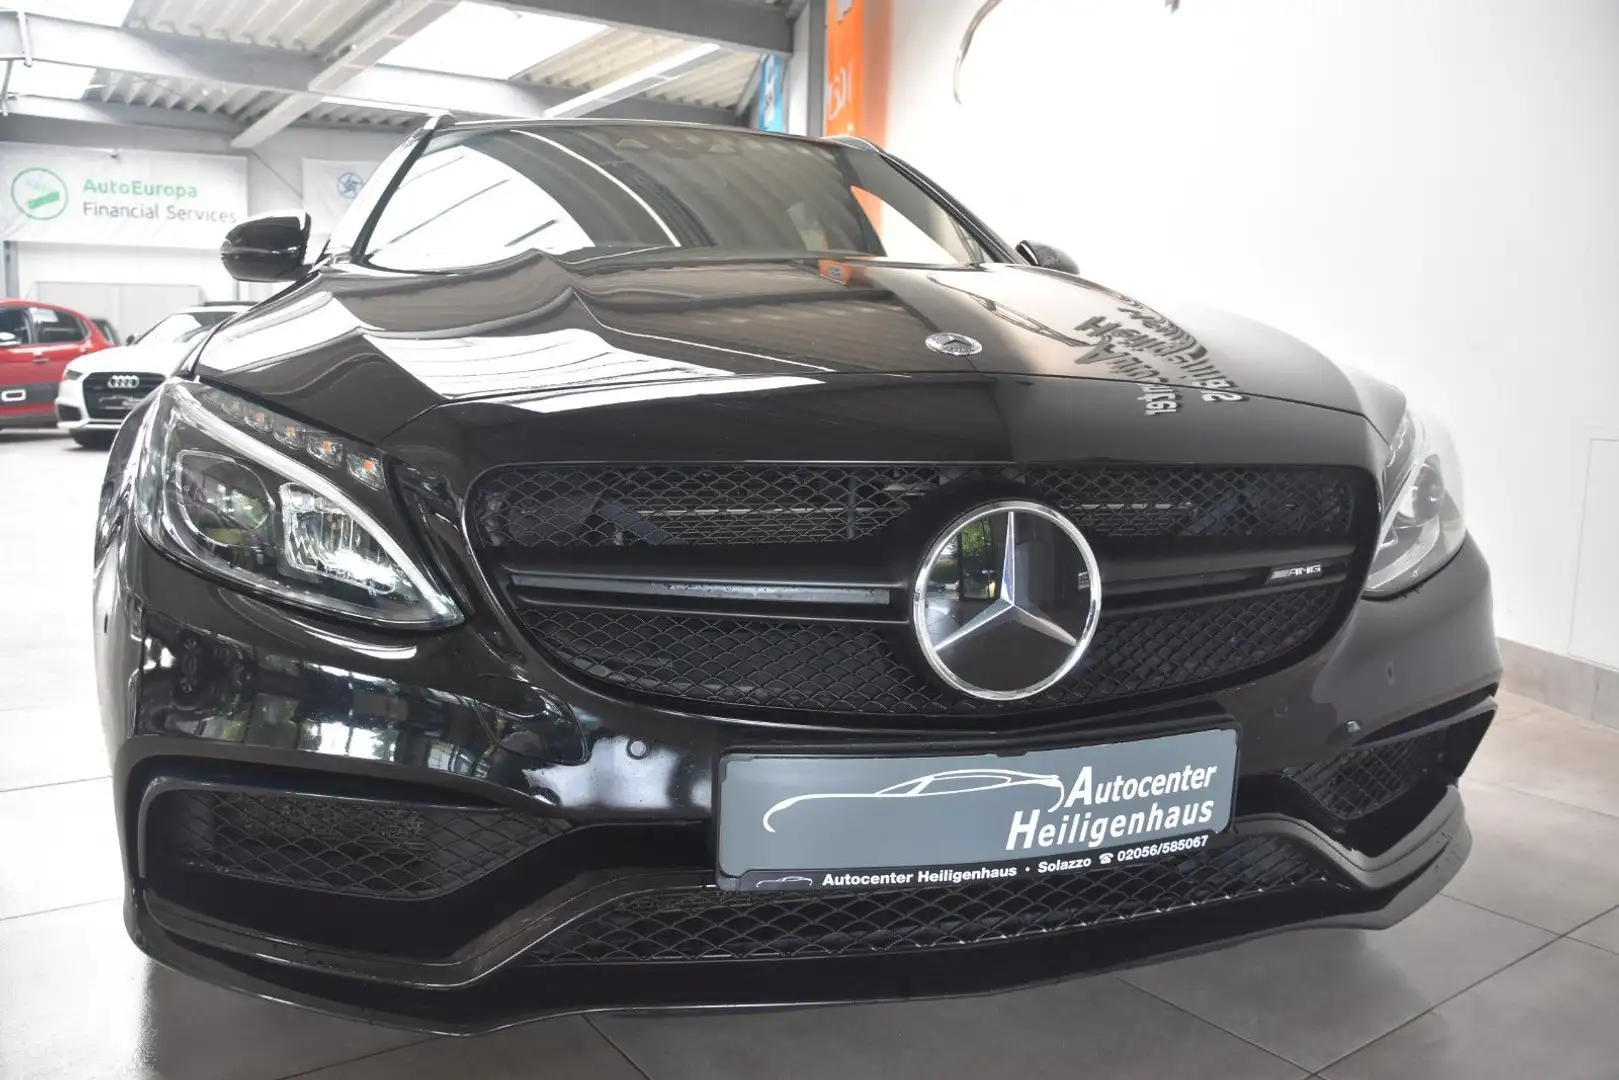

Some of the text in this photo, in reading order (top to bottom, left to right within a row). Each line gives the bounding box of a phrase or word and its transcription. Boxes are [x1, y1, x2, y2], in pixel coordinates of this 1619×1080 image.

[83, 178, 198, 200] AutoEuropa
[83, 201, 237, 224] Financial Services
[1288, 564, 1321, 576] AMG
[1063, 764, 1218, 808] Autocenter
[1005, 800, 1214, 851] Heiligenhaus
[822, 834, 1209, 886] Autocenter Heiligenhaus Solazzo 02056/585067
